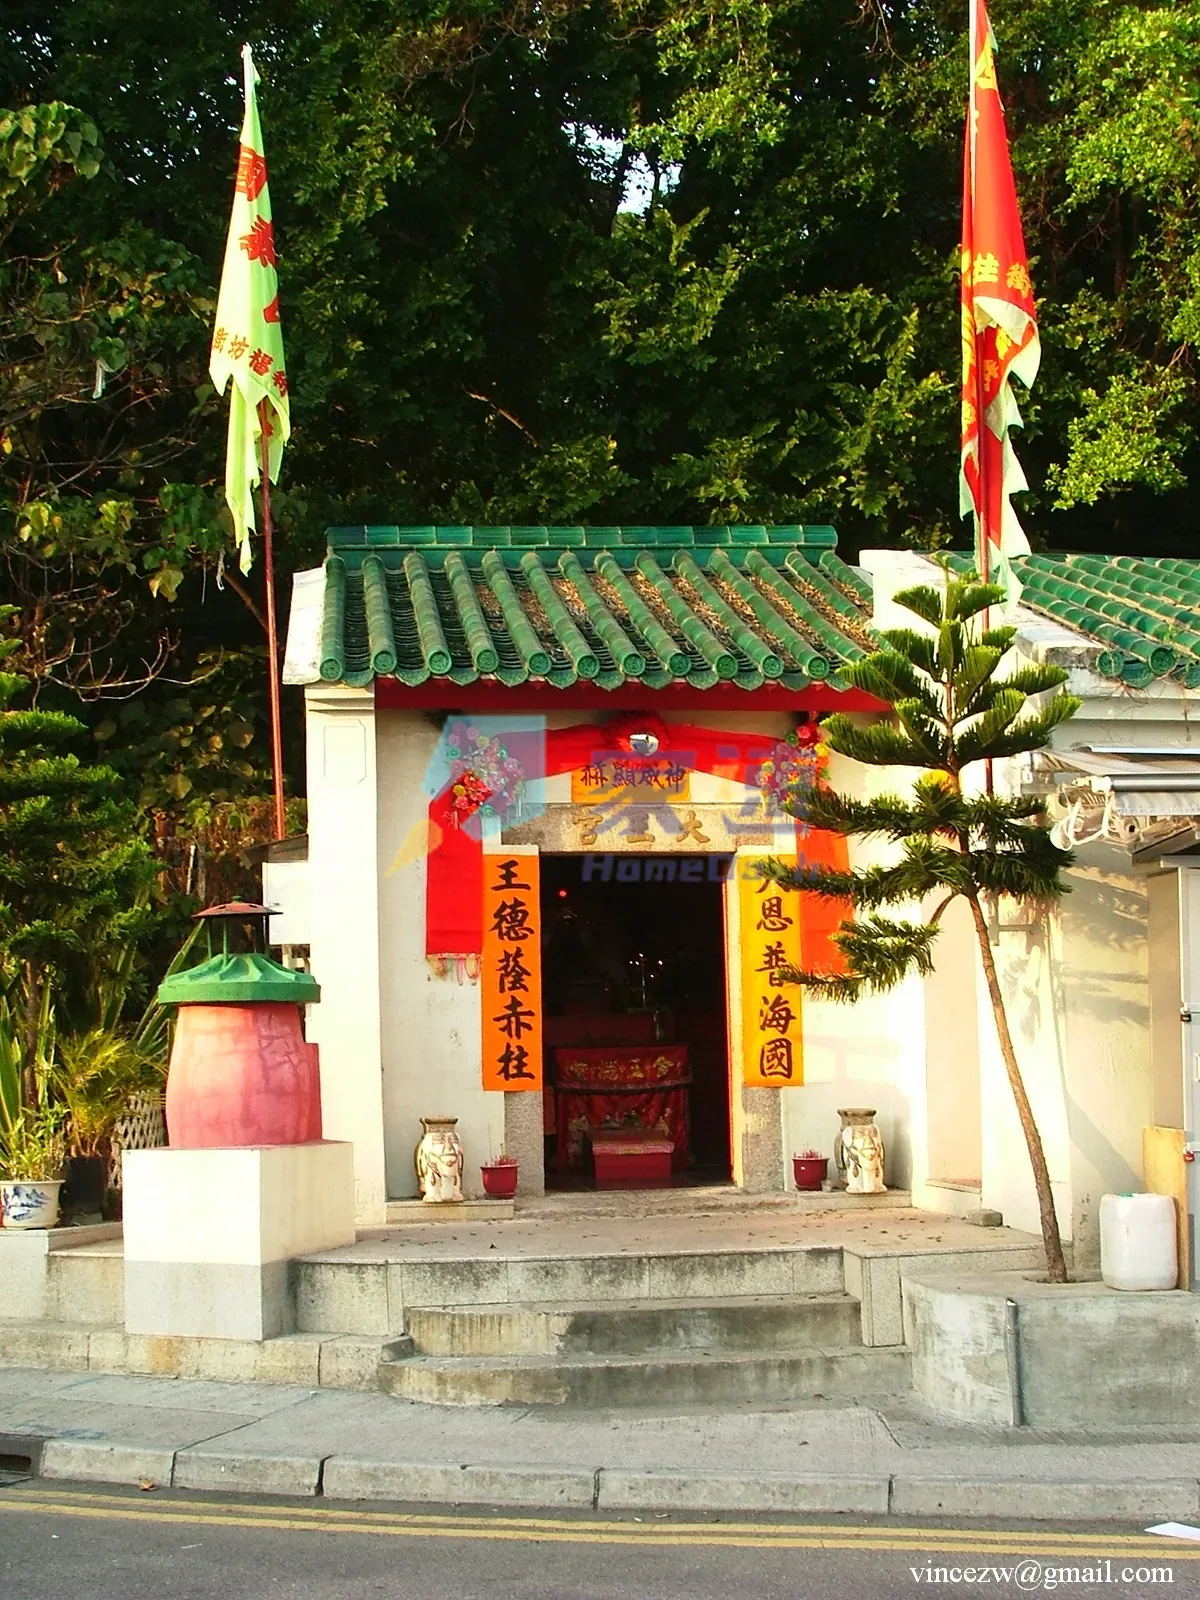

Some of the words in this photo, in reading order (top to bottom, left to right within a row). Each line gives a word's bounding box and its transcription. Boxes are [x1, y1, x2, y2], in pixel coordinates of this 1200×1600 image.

[489, 859, 536, 1082] 王德蔭赤柱
